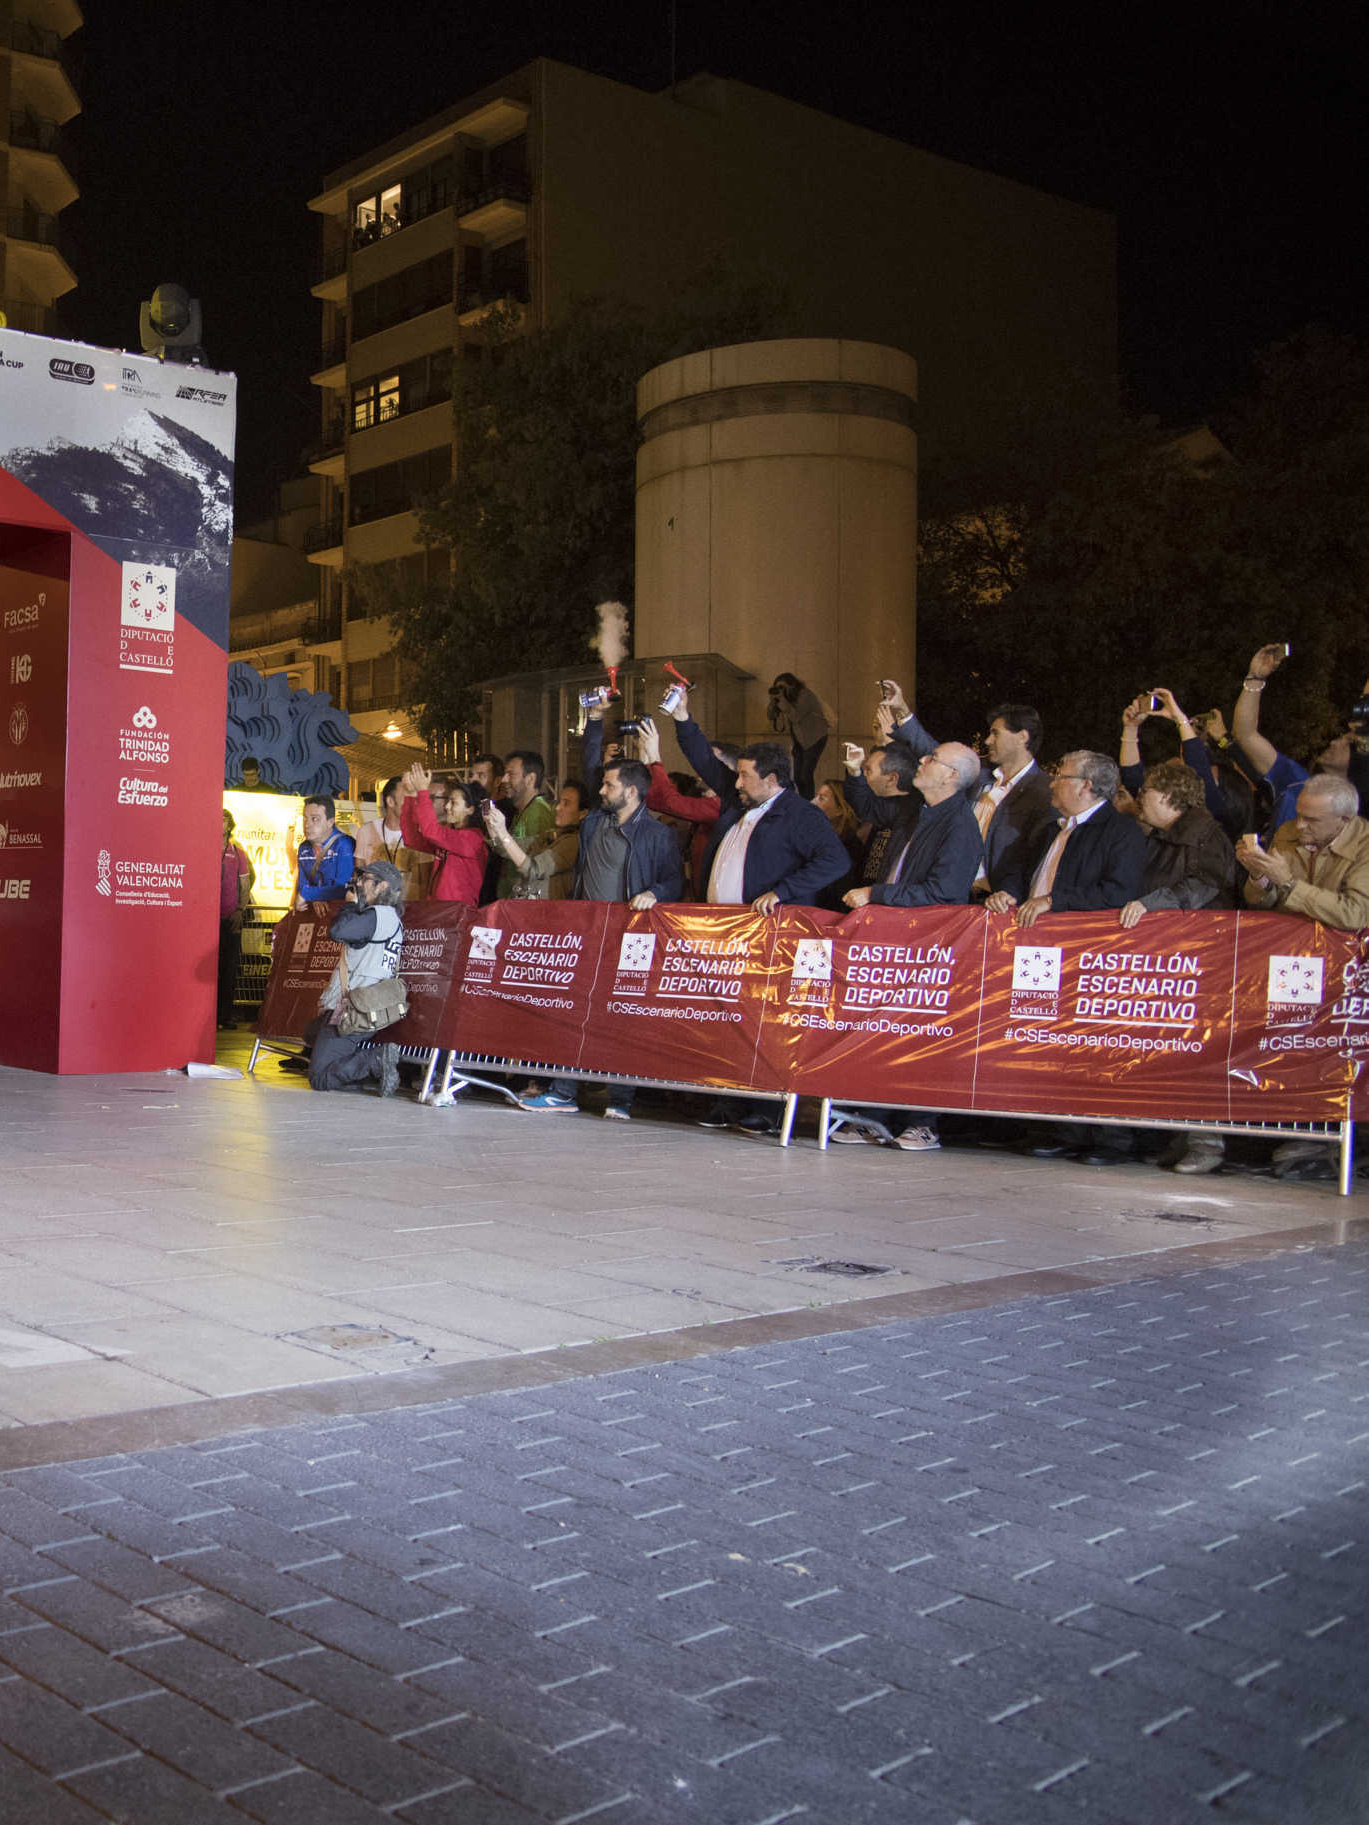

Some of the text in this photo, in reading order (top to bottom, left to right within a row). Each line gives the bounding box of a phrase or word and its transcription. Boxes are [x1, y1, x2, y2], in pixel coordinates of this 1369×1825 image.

[5, 361, 24, 369] CUP
[120, 628, 174, 644] DIPUTACIÓ
[119, 652, 174, 667] CASTELLÓ
[119, 729, 170, 740] FUNDACIÓN
[118, 738, 170, 753] TRINIDAD
[118, 750, 170, 764] ALFONSO
[119, 777, 168, 793] Cultura del
[117, 790, 168, 807] Esfuerzo
[9, 833, 42, 845] BENASSAL
[115, 861, 185, 875] GENERALITAT
[115, 874, 183, 888] VALENCIANA
[509, 931, 583, 951] CASTELLÓN,
[665, 937, 751, 957] CASTELLÓN,
[504, 949, 579, 968] ESCENARIO
[847, 943, 956, 965] CASTELLÓN,
[662, 957, 745, 975] ESCENARIO
[1078, 952, 1204, 976] CASTELLÓN,
[502, 965, 575, 984] DEPORTIVO
[845, 966, 951, 985] ESCENARIO
[658, 976, 742, 996] DEPORTIVO
[1077, 975, 1198, 997] ESCENARIO
[844, 986, 950, 1007] DEPORTIVO
[607, 1001, 742, 1023] #CSEscenarioDeportivo
[1075, 998, 1196, 1021] DEPORTIVO
[782, 1013, 954, 1037] #CSEscenarioDeportivo
[1004, 1027, 1203, 1053] #CSEscenarioDeportivo
